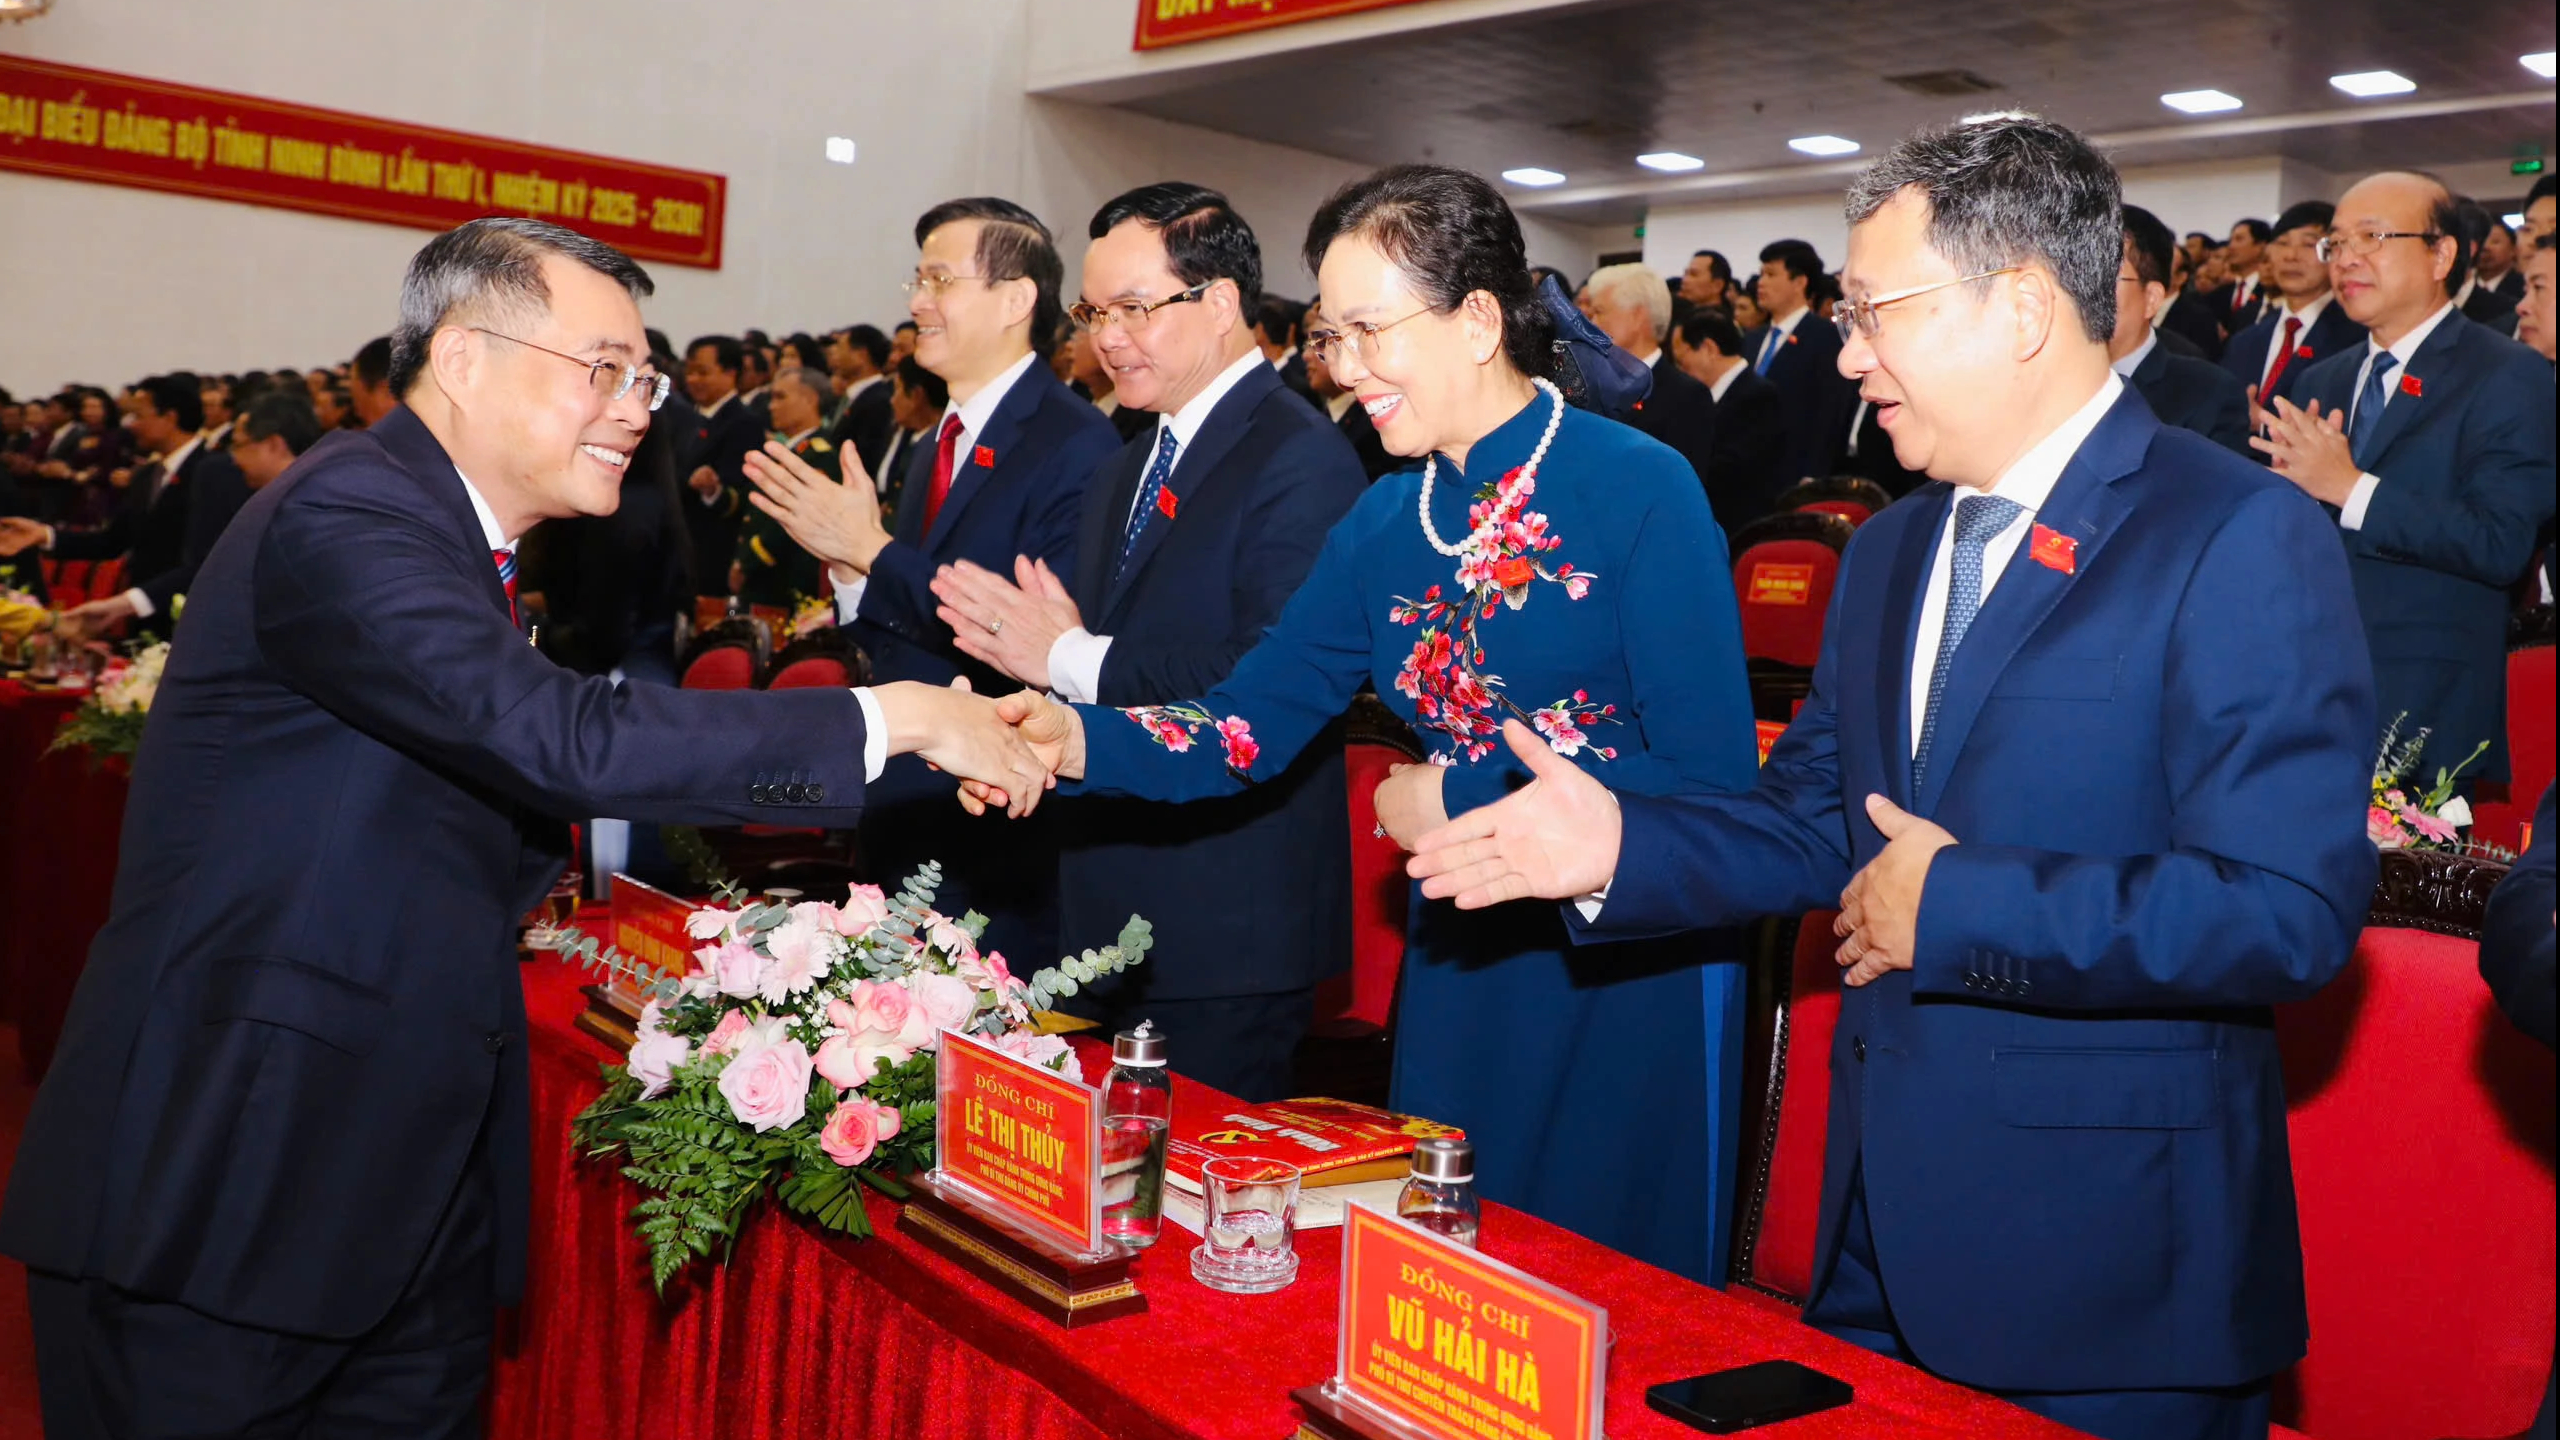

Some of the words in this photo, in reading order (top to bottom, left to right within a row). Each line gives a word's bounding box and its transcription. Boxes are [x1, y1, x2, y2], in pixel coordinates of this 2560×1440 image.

[42, 90, 99, 146] BIỂU
[104, 99, 171, 157] ĐẢNG
[174, 117, 208, 171] BỘ
[213, 116, 266, 171] TỈNH
[269, 136, 326, 181] NINH
[590, 187, 636, 227] 2025
[965, 1095, 984, 1137] LÊ
[988, 1108, 1015, 1159] THỊ
[1020, 1122, 1065, 1175] THỦY
[974, 1073, 1020, 1104] ĐỒNG
[1025, 1096, 1055, 1120] CHÍ
[1401, 1262, 1473, 1313] ĐỒNG
[1481, 1302, 1530, 1339] CHÍ
[1388, 1293, 1425, 1350] VŨ
[1434, 1315, 1486, 1384] HẢI
[1495, 1346, 1541, 1412] HÀ
